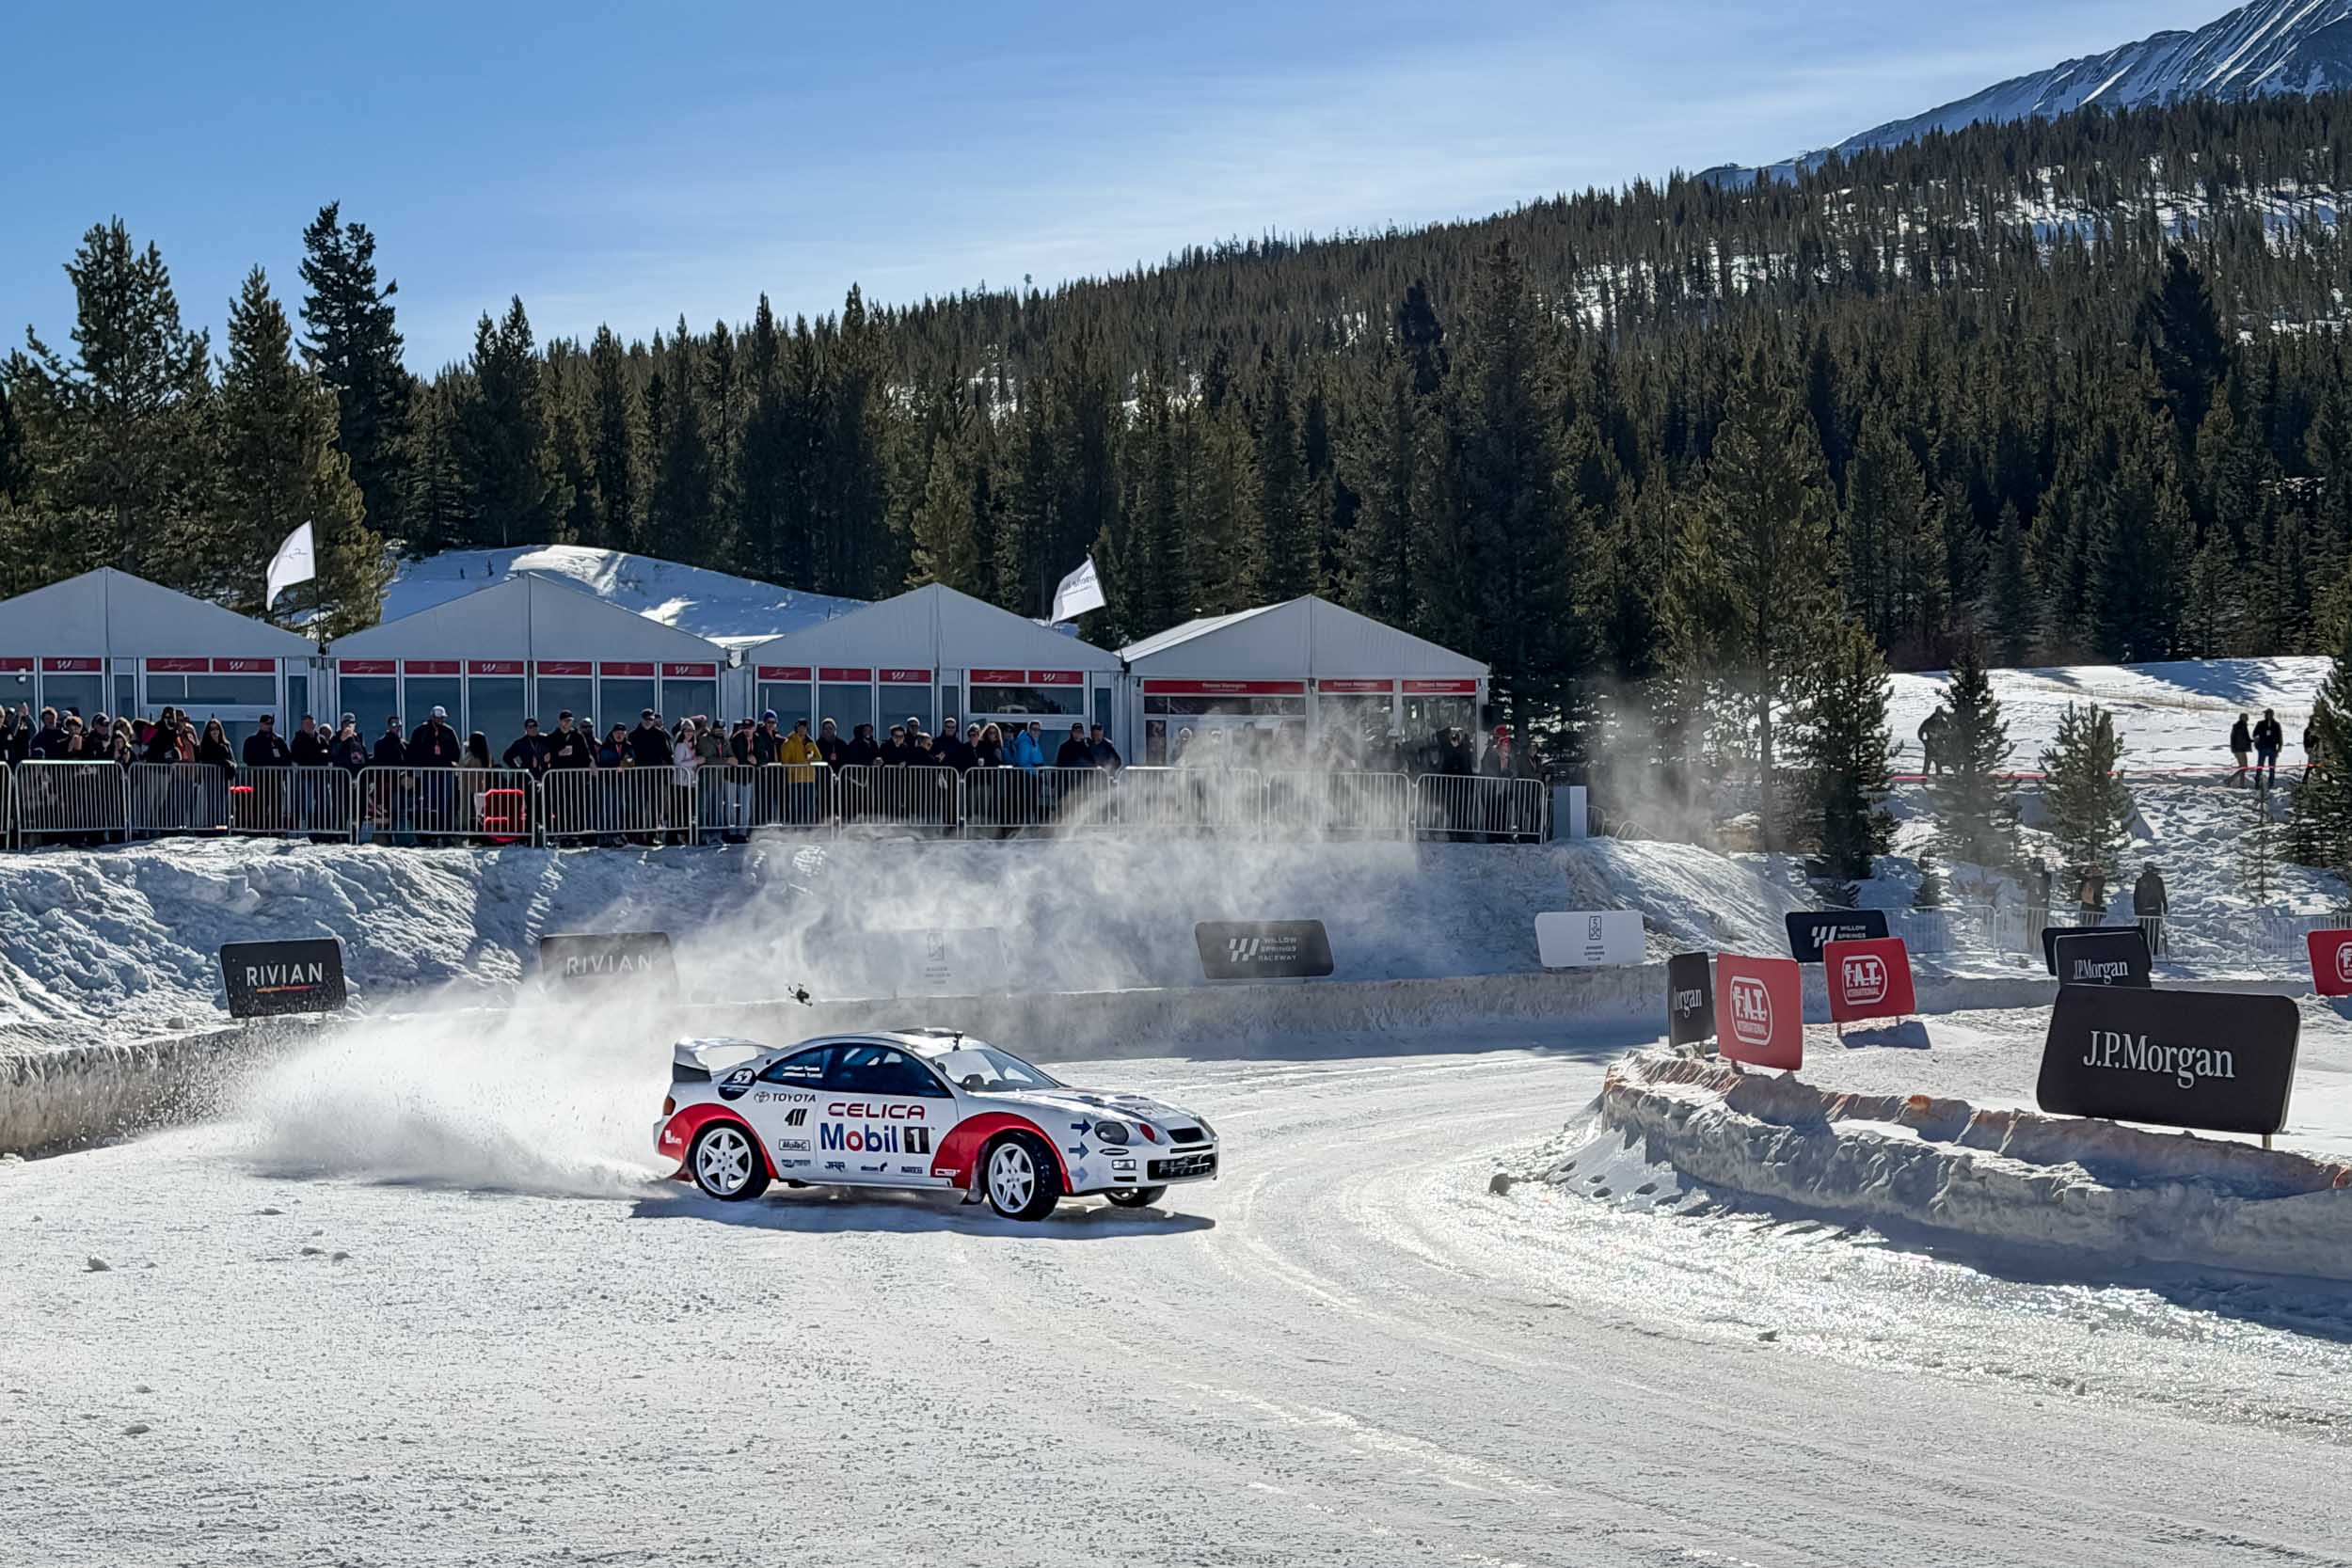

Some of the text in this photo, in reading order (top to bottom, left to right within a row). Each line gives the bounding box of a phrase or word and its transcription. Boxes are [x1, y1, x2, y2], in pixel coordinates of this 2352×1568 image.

[246, 962, 324, 987] RIVIAN
[565, 954, 653, 975] RIVIAN
[2083, 1030, 2236, 1089] J.P.Morgan
[733, 1070, 753, 1085] 52
[772, 1092, 817, 1103] TOYOTA
[828, 1102, 926, 1120] CELICA
[819, 1122, 898, 1153] Mobil
